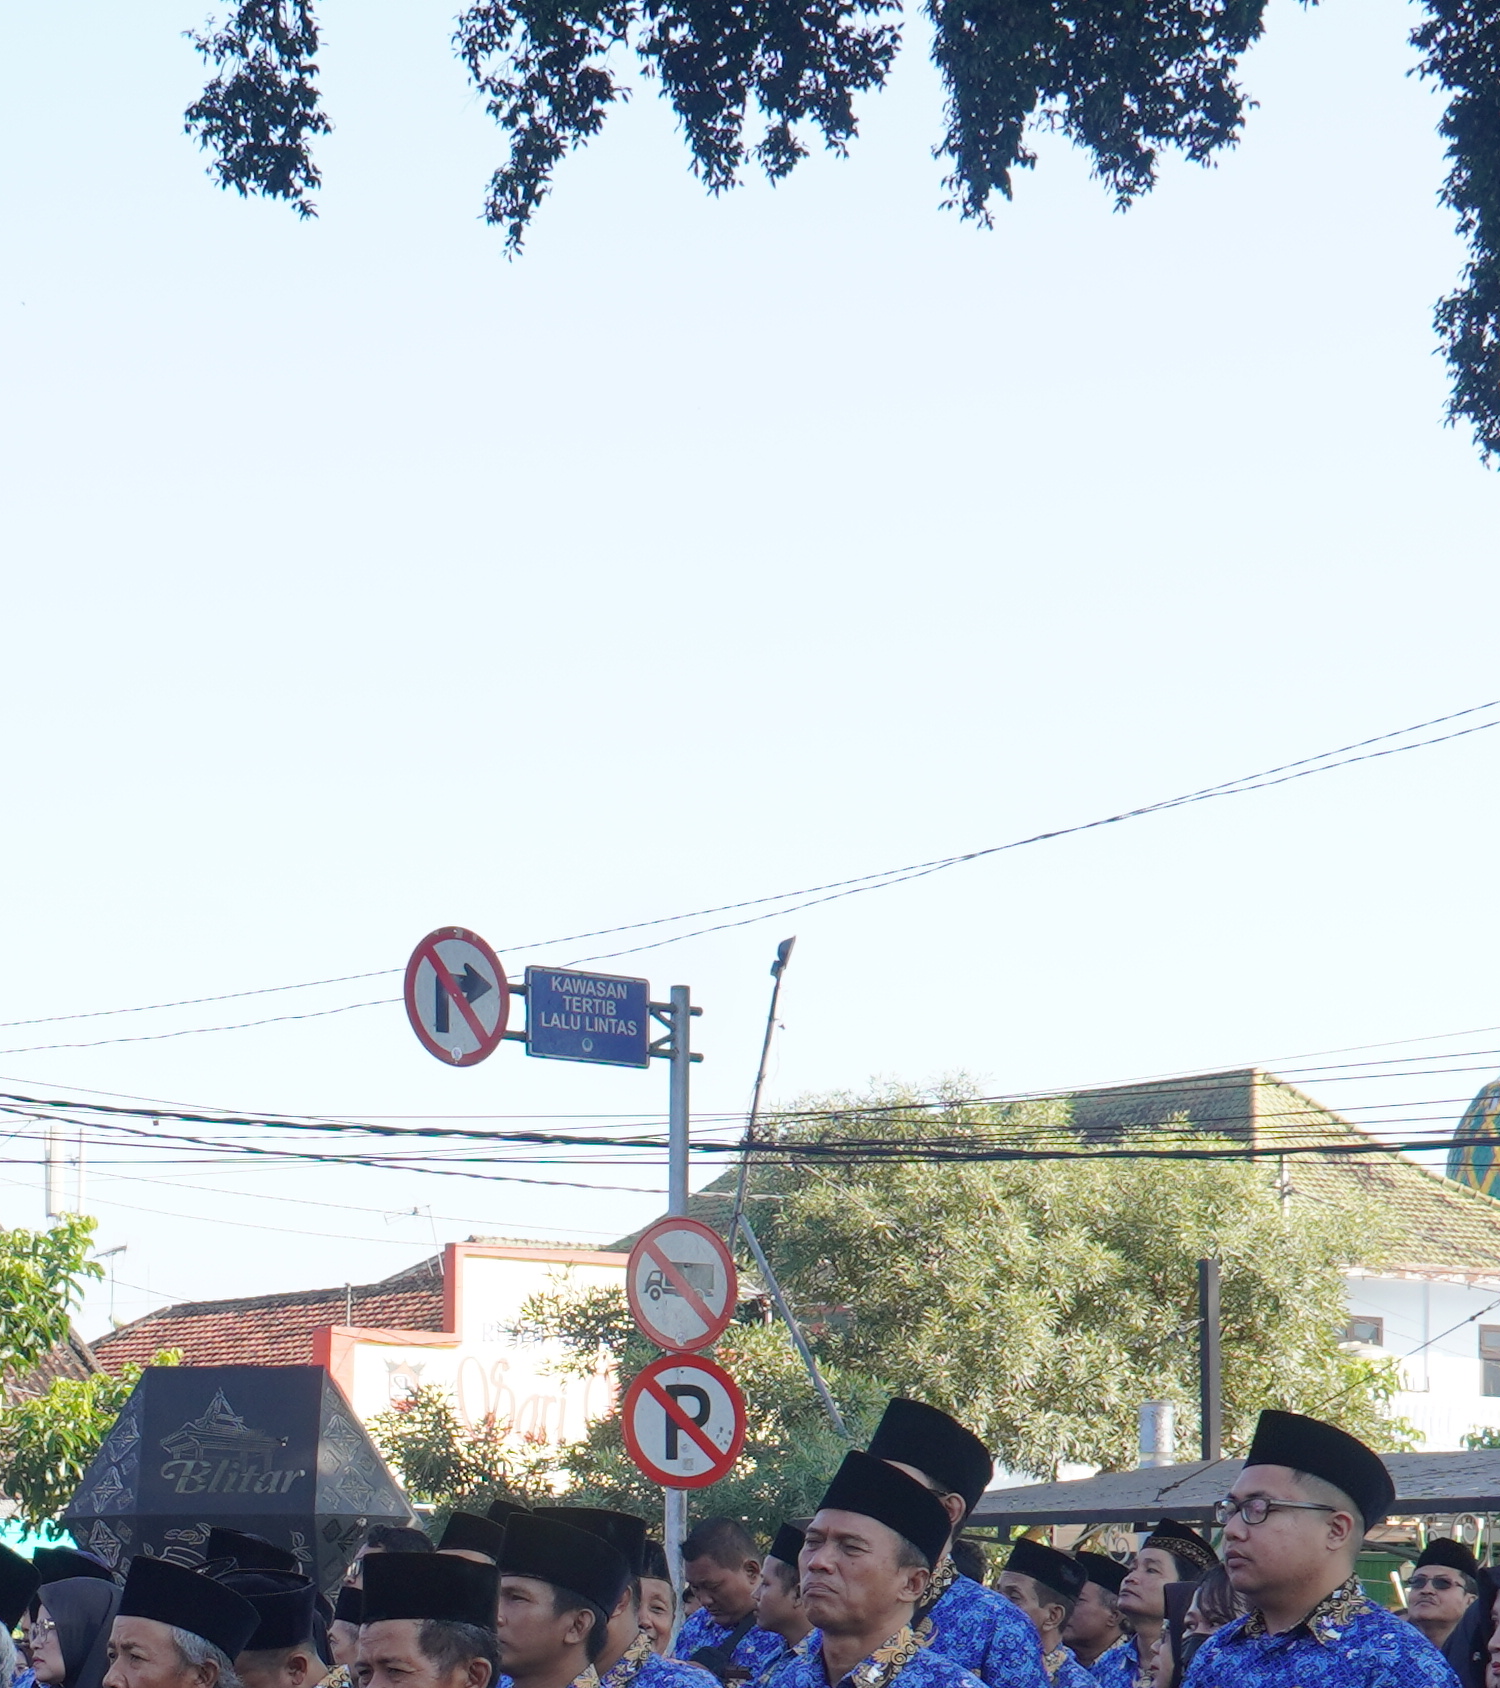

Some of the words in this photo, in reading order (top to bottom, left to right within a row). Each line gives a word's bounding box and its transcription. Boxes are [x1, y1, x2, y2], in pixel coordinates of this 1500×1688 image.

[551, 975, 628, 1000] KAWASAN
[562, 995, 617, 1016] TERTIB
[541, 1011, 581, 1031] LALU
[585, 1015, 637, 1036] LINTAS
[665, 1384, 711, 1460] P
[160, 1458, 306, 1495] Blitar
